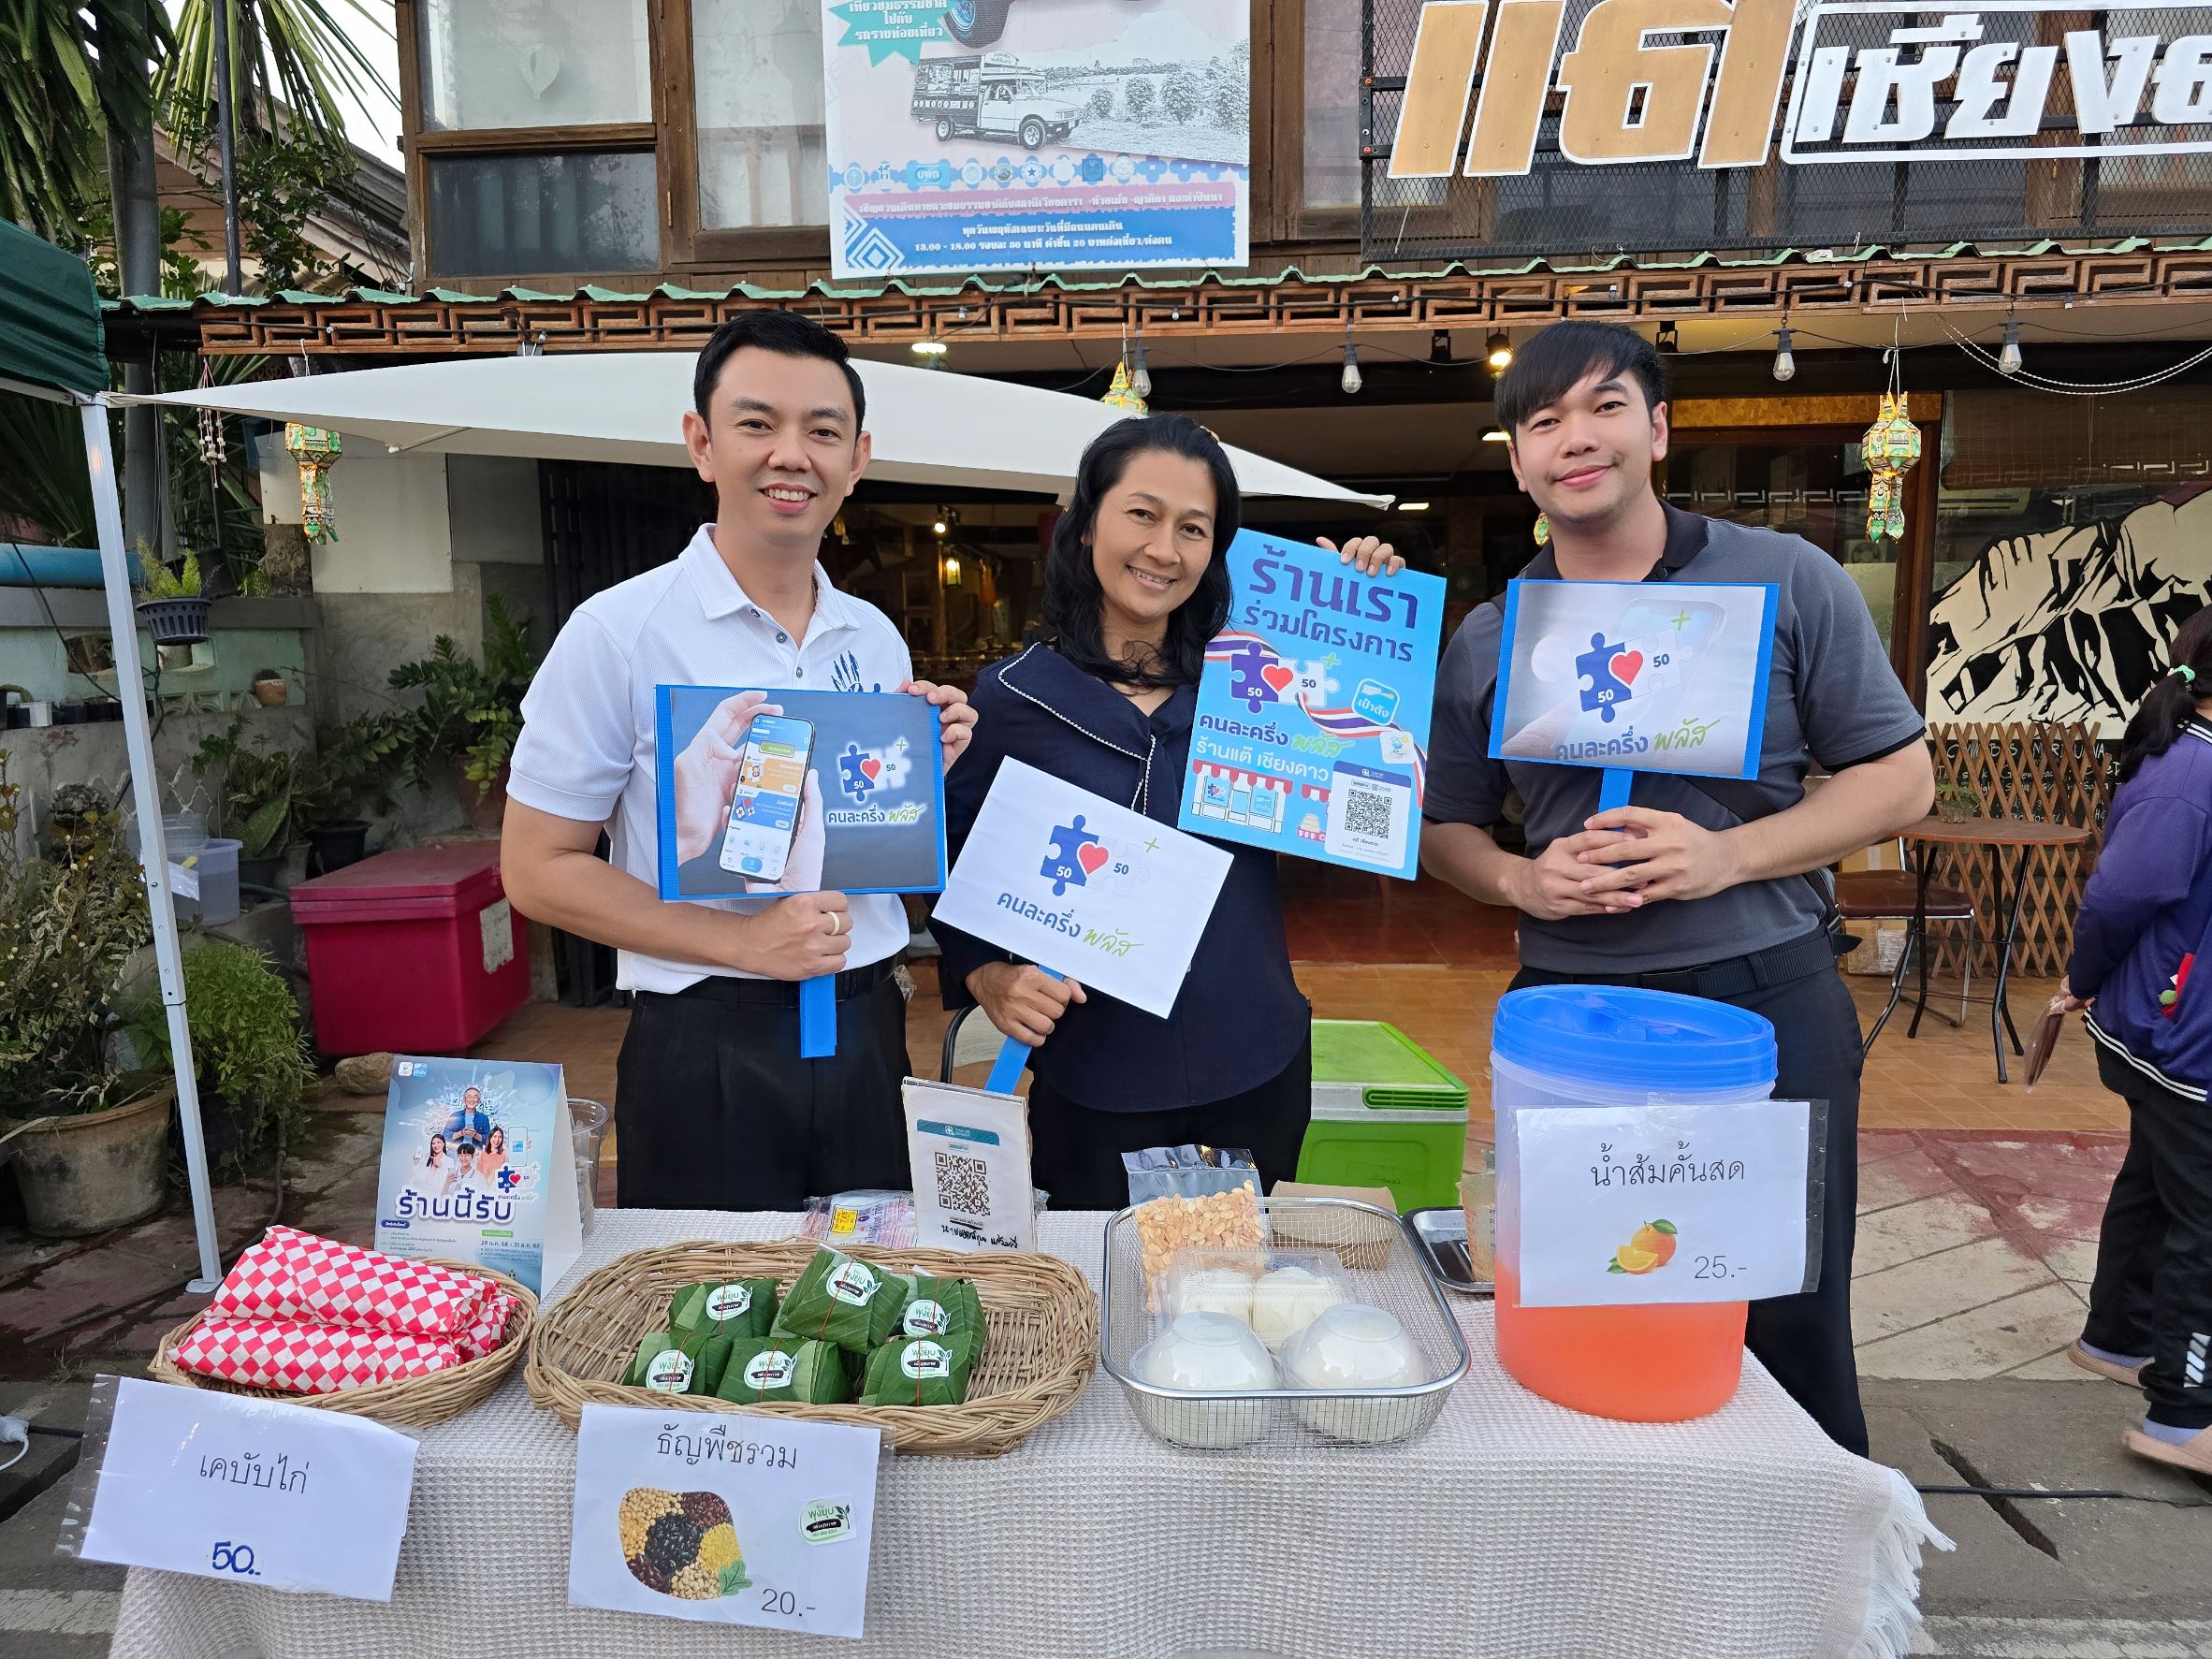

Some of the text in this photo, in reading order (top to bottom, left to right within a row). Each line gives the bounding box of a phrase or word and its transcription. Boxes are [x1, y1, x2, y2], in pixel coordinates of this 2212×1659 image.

[1249, 544, 1419, 630] ร้านเรา
[1244, 599, 1414, 662] ร่วมโครงการ
[1652, 653, 1670, 668] 50
[1246, 687, 1263, 698] 50
[1302, 678, 1317, 689] 50
[1597, 689, 1614, 702] 50
[1199, 713, 1355, 757] คนละครึ่ง พลัส
[1556, 717, 1722, 761] คนละครึ่ง พลัส
[885, 763, 896, 772] 50
[1196, 735, 1330, 782] ร้านแต๊ เชียงดาว
[853, 779, 865, 790] 50
[828, 804, 925, 822] คนละครึ่ง พลัส
[1055, 866, 1072, 879] 50
[1113, 863, 1129, 875] 50
[997, 892, 1145, 957] คนละครึ่ง พลัส
[1590, 1140, 1745, 1186] น้ำส้มคั้นสด
[399, 1187, 512, 1220] ร้านนี้รับ
[1693, 1255, 1748, 1279] 25.-
[657, 1424, 797, 1470] ธัญพืชรวม
[199, 1452, 311, 1494] เคบับไก่
[761, 1588, 816, 1617] 20.-
